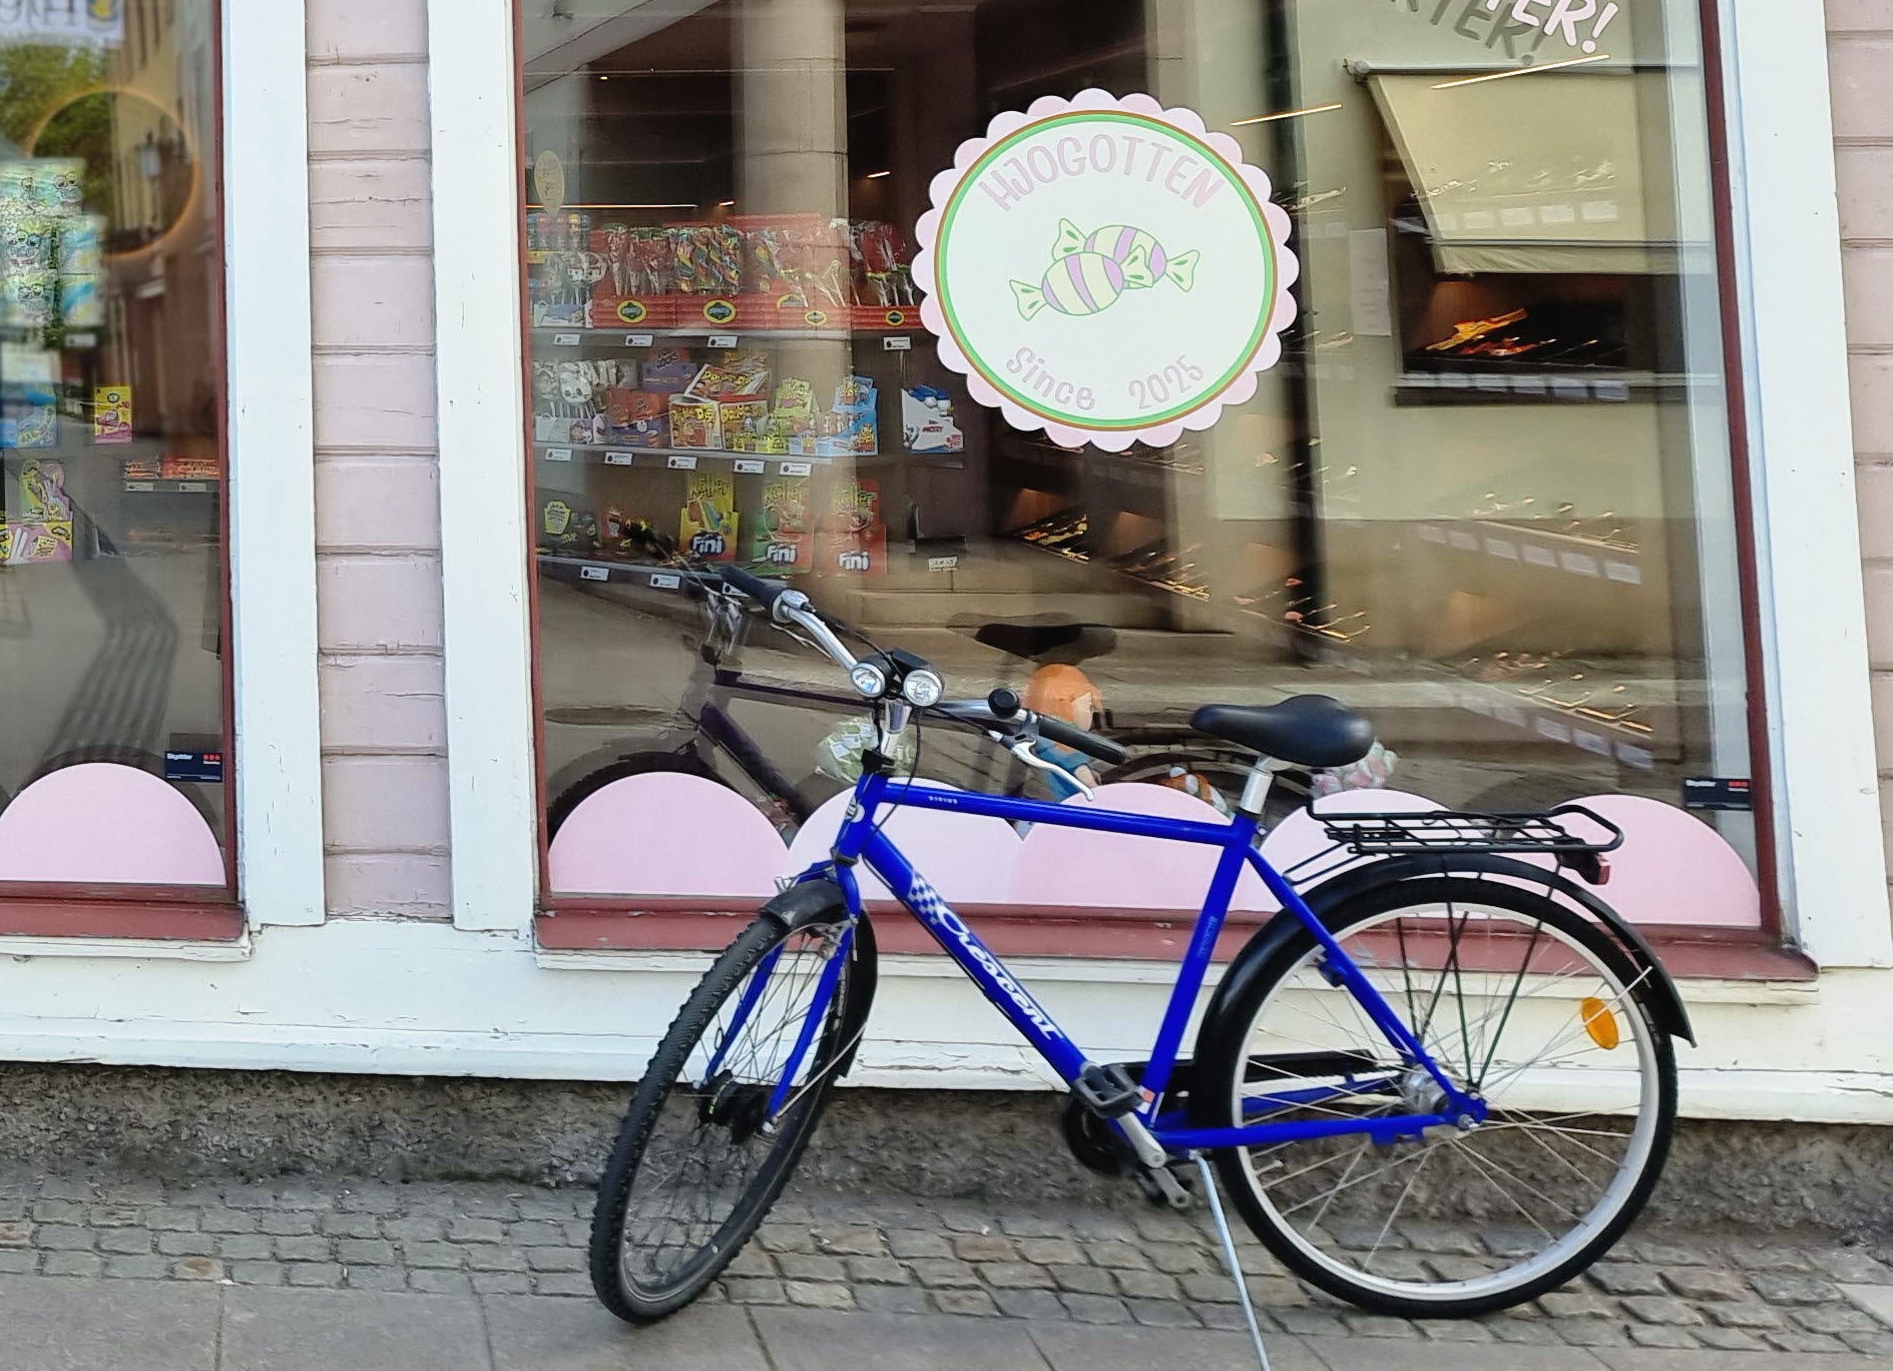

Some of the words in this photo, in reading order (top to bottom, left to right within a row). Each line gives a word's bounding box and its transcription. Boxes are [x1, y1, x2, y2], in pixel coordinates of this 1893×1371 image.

[978, 133, 1225, 212] HJOGOTTEN
[1006, 346, 1096, 412] Since
[1128, 354, 1204, 411] 2025
[693, 535, 723, 554] Fini
[767, 544, 797, 562] Fini
[839, 552, 869, 570] Fini
[936, 905, 1064, 1041] Crescent
